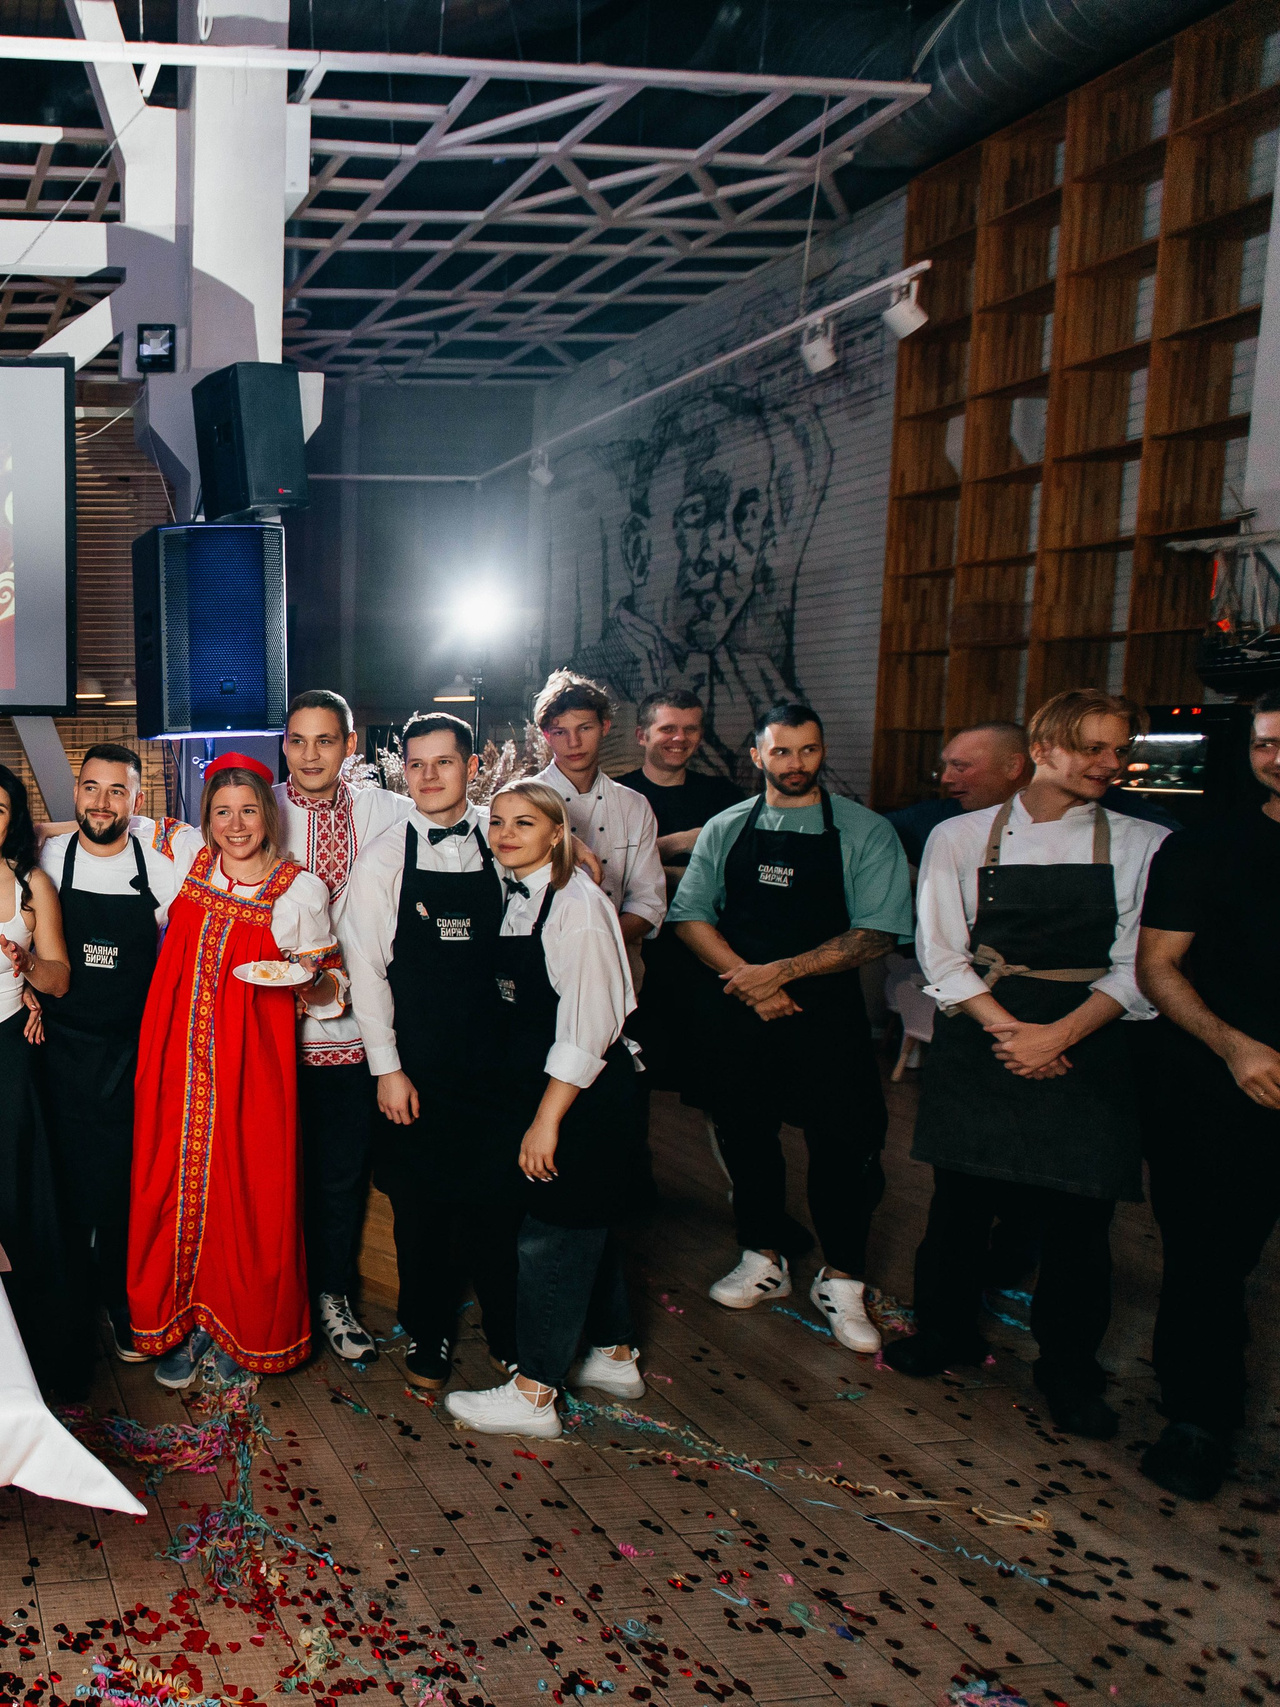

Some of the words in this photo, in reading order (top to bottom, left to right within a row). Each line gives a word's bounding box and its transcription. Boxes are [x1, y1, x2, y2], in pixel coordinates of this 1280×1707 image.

[437, 918, 471, 928] СОЛЯНАЯ
[440, 928, 469, 937] БИРЖА
[83, 943, 118, 956] СОЛЯНАЯ
[85, 953, 114, 965] БИРЖА
